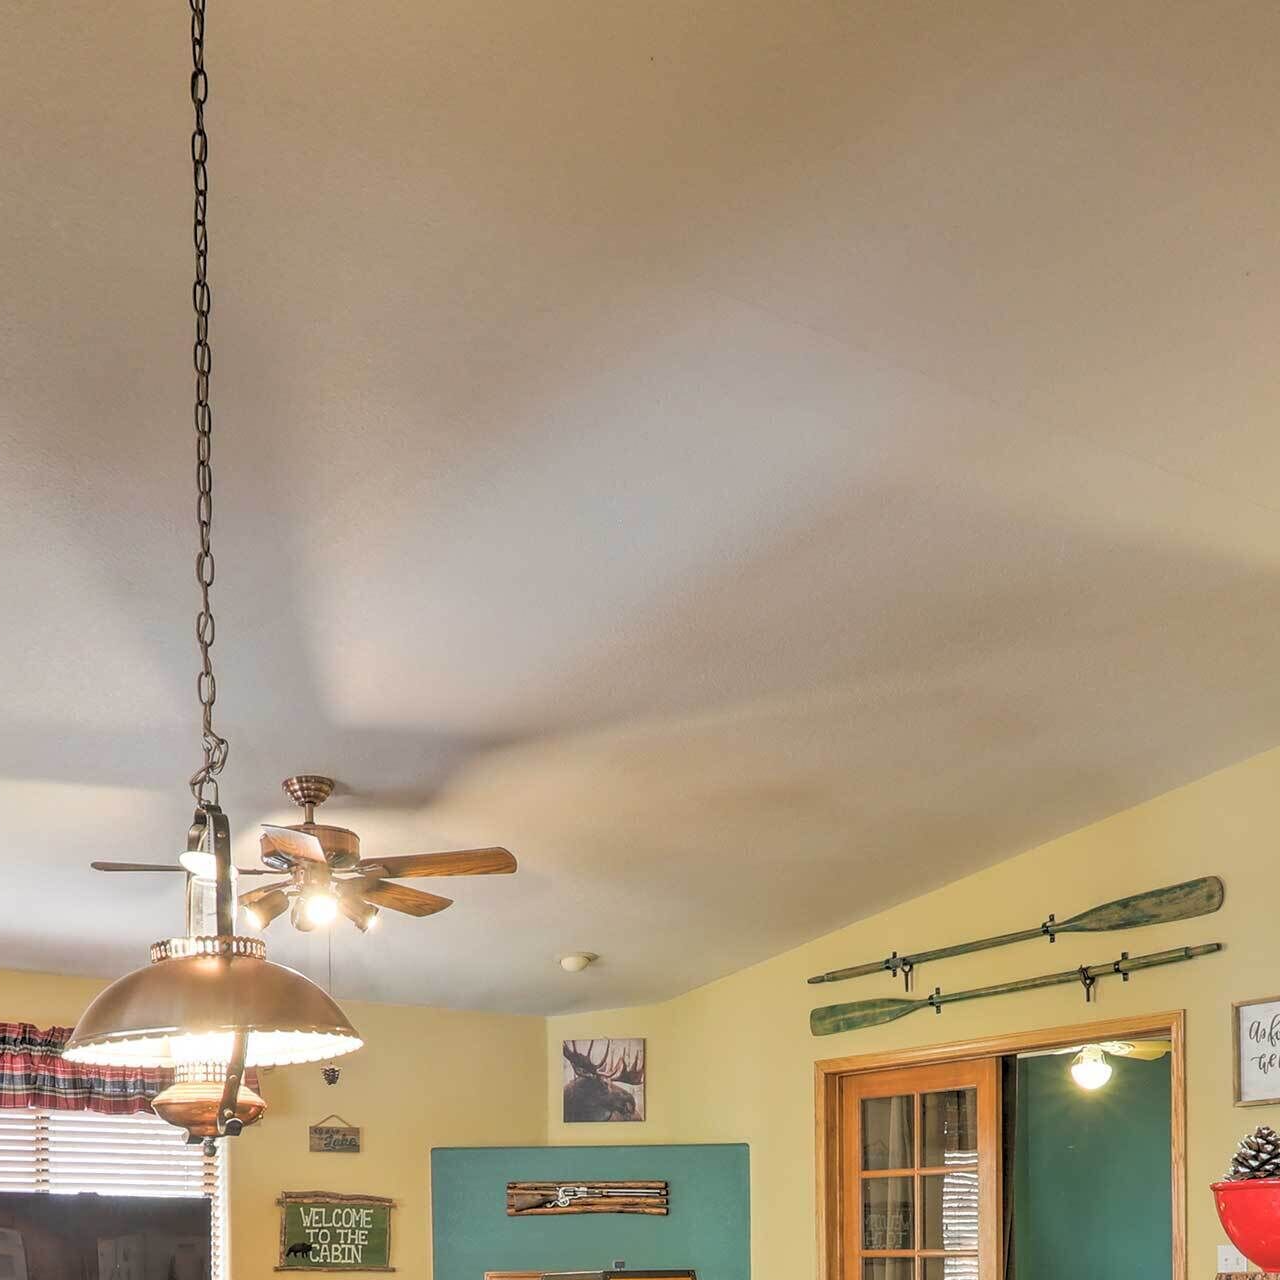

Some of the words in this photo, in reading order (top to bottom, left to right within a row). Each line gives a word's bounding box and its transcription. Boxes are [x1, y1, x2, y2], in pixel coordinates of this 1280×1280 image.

[1249, 1020, 1266, 1043] As
[1251, 1053, 1277, 1074] we
[299, 1207, 373, 1228] WELCOME
[305, 1229, 331, 1243] TO
[336, 1229, 369, 1245] THE
[309, 1245, 363, 1263] CABIN
